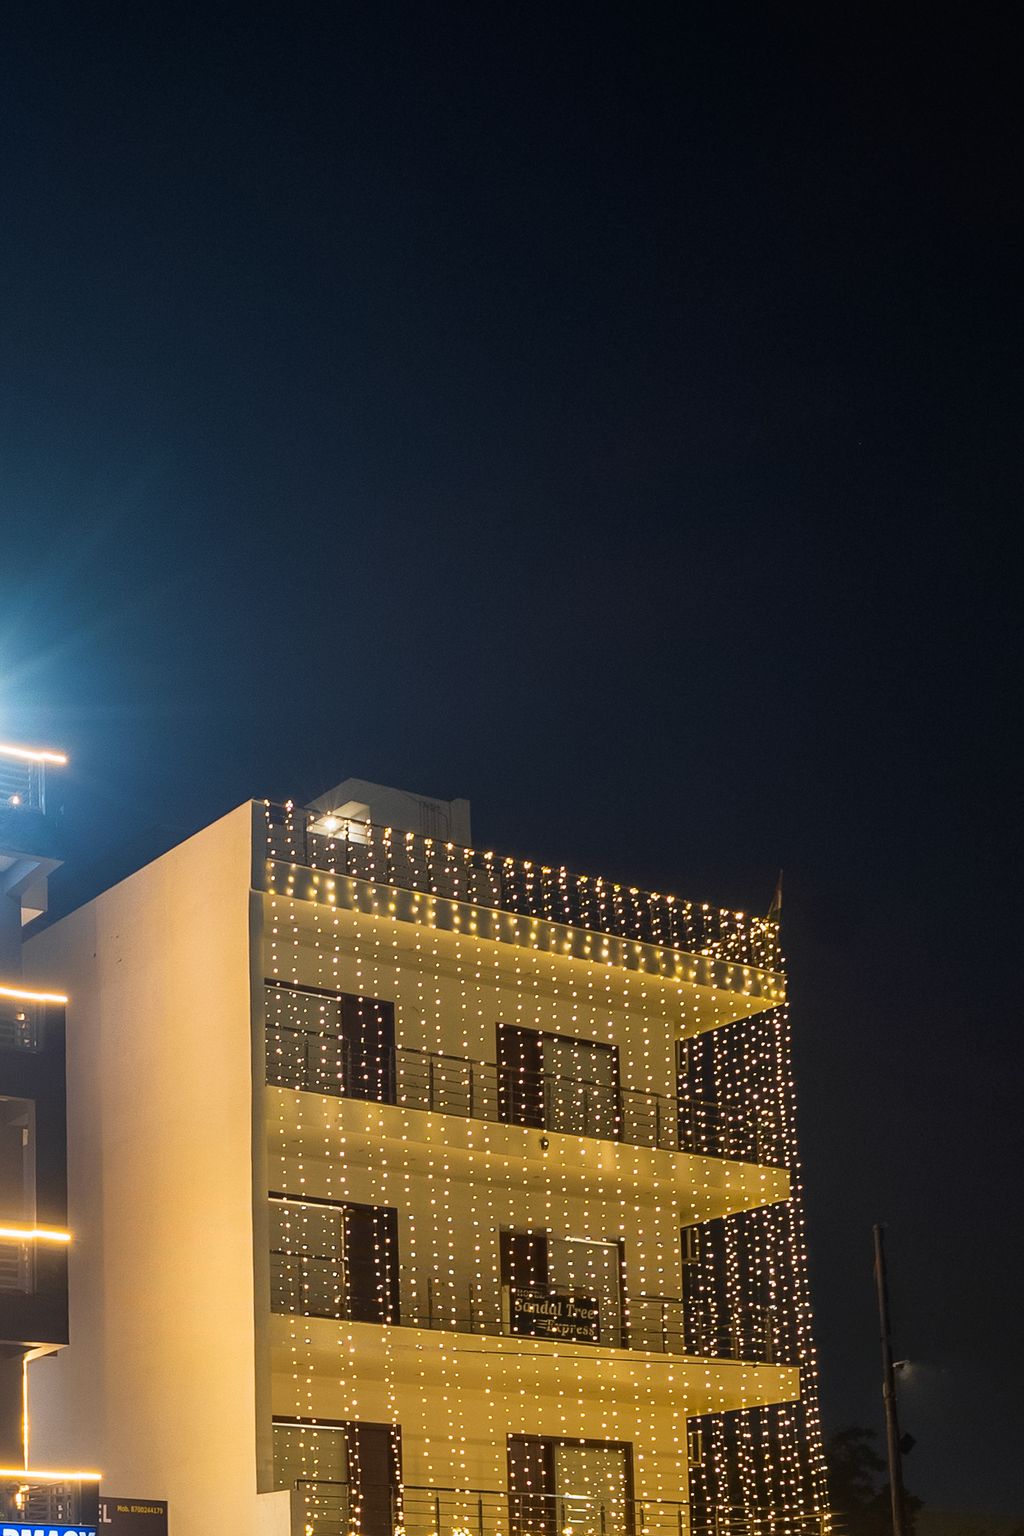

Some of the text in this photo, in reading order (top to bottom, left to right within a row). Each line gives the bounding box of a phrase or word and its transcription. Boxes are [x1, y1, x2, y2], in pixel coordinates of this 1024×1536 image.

[514, 1298, 596, 1319] Sandal Tree
[546, 1319, 596, 1336] Express
[99, 1504, 112, 1523] L
